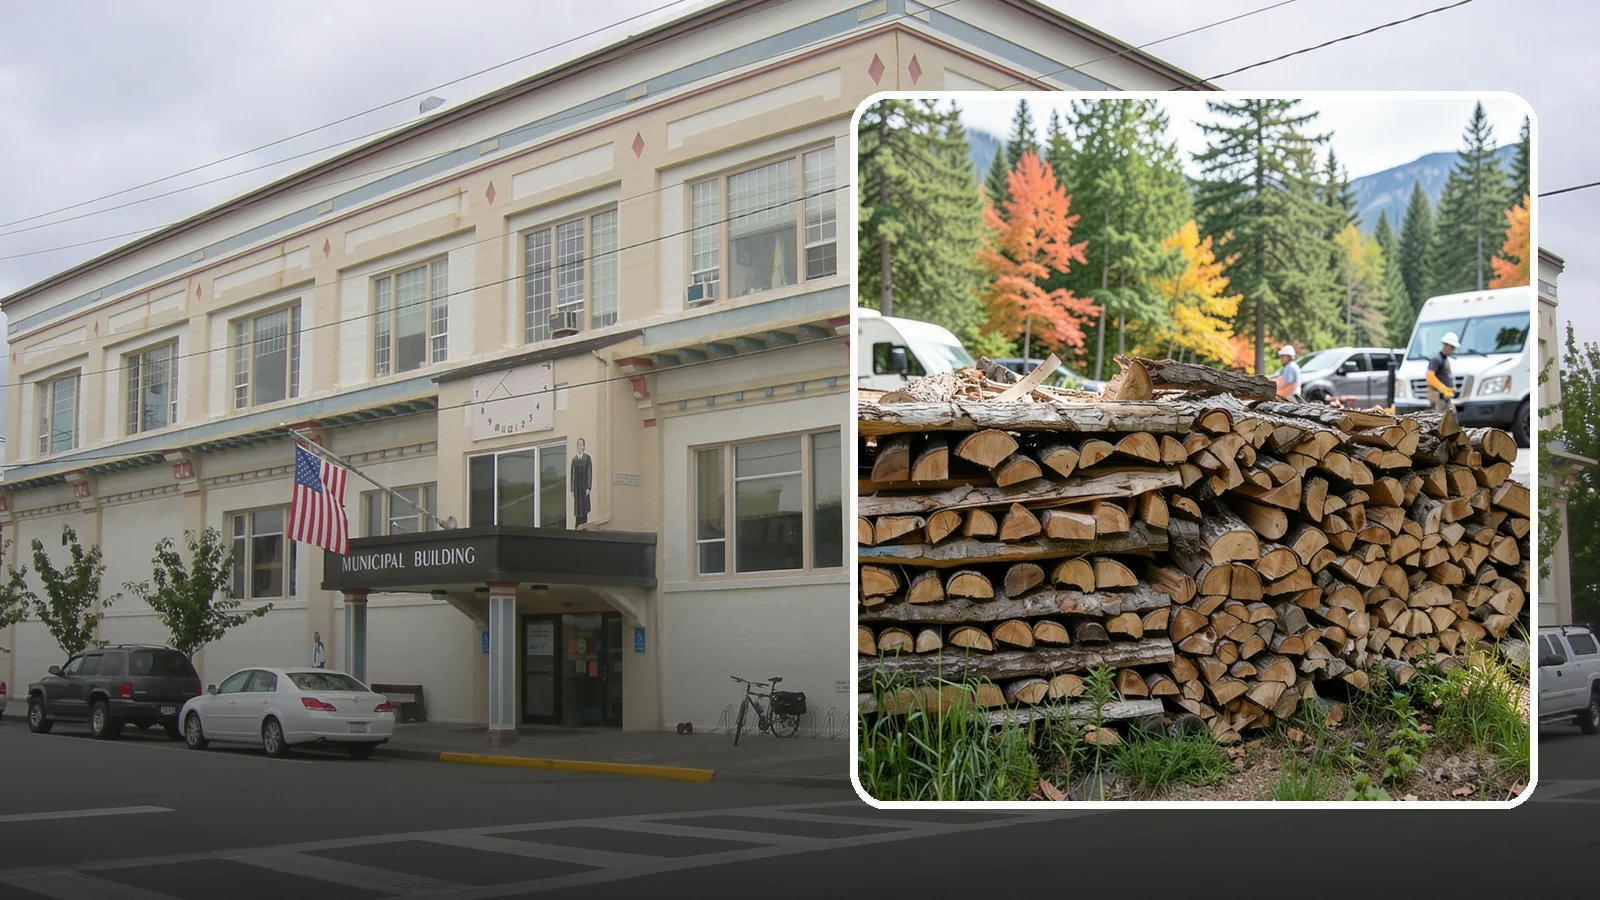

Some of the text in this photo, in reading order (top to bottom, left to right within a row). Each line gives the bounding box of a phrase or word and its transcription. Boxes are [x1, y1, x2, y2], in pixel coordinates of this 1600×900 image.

[481, 407, 485, 415] 8
[529, 414, 533, 422] 3
[342, 546, 475, 572] MUNICIPAL BUILDING
